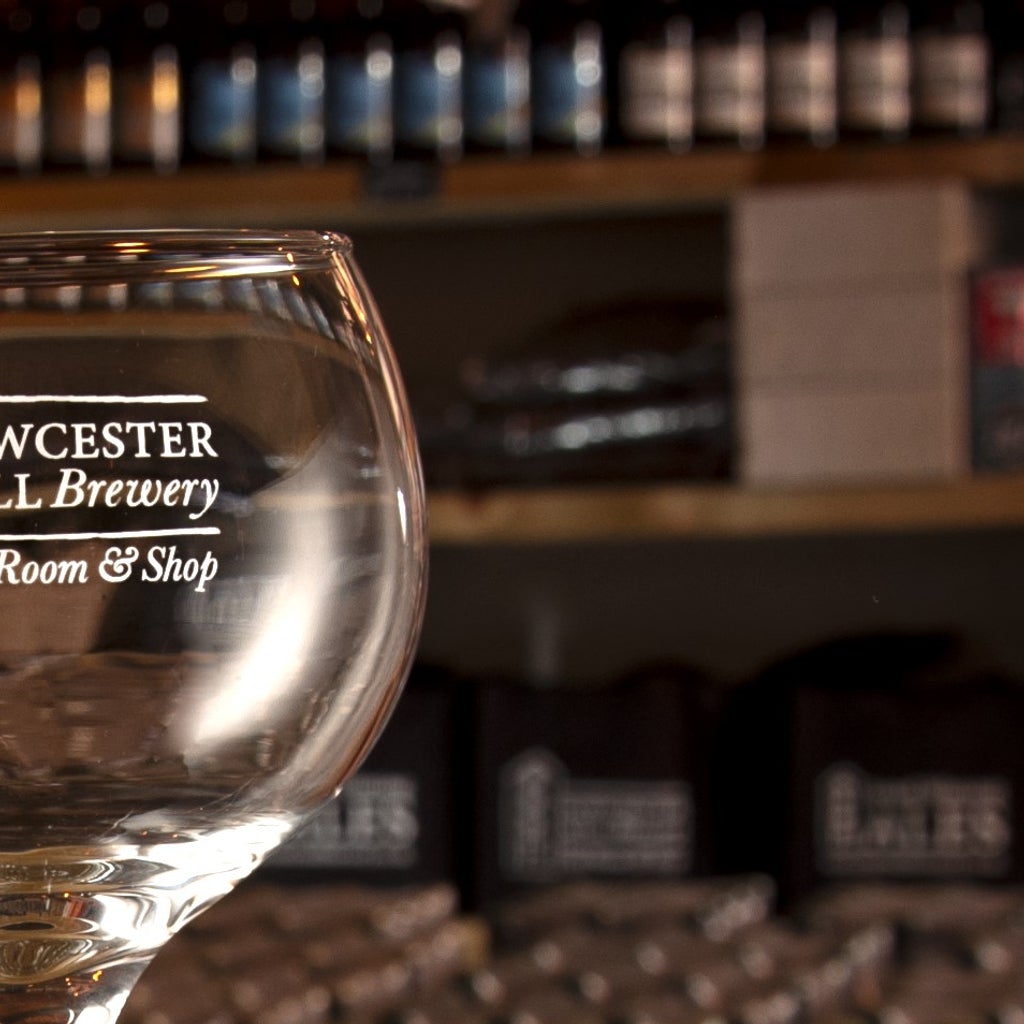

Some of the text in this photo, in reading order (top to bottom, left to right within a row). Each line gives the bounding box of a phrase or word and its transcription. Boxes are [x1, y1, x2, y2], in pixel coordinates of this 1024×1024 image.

[49, 468, 220, 520] Brewery
[98, 546, 140, 583] &
[141, 545, 219, 593] Shop
